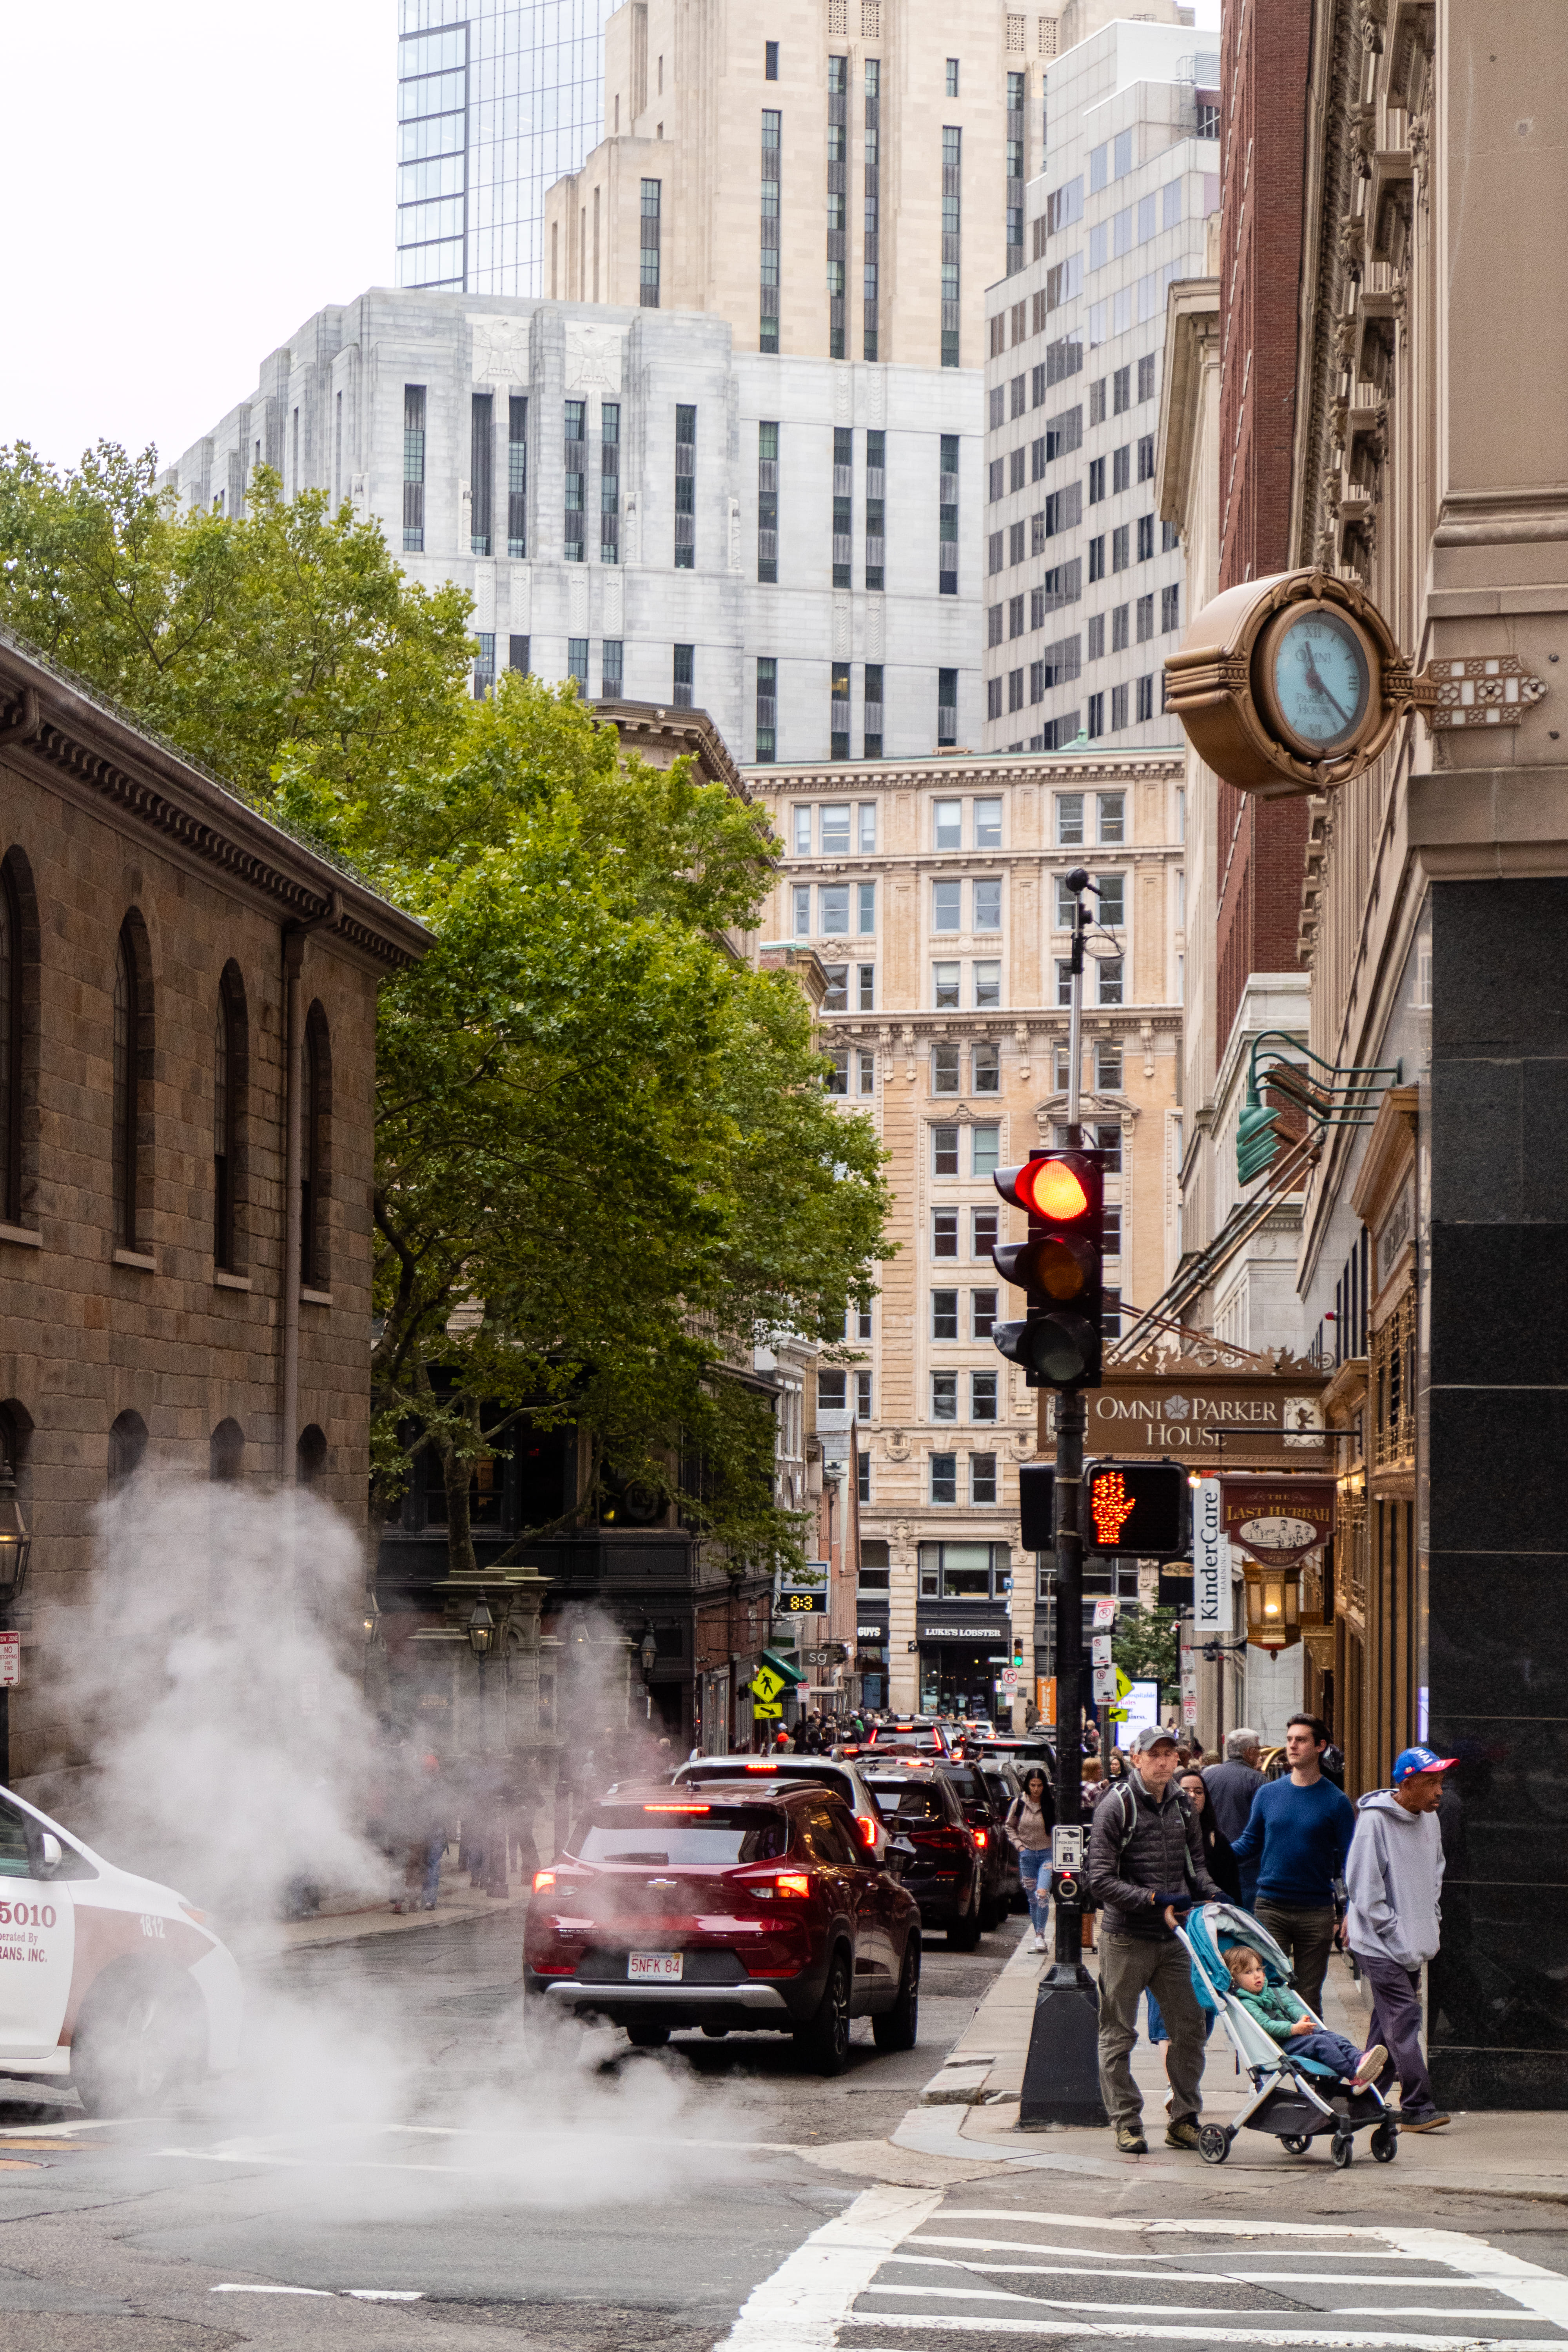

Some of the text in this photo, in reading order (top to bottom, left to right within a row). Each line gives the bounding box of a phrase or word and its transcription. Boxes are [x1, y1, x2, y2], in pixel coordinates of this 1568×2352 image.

[1304, 627, 1321, 637] XII
[1296, 692, 1332, 704] PARKE
[1096, 1396, 1278, 1421] OMNI PARKER
[1146, 1423, 1227, 1446] HOUSE
[1226, 1506, 1330, 1522] LAST HURRAH
[1201, 1492, 1218, 1621] KinderCare
[857, 1627, 881, 1637] GUYS
[809, 1653, 828, 1665] sg
[0, 1901, 56, 1928] 5010
[140, 1915, 165, 1938] 1812
[28, 1933, 38, 1945] By
[28, 1948, 47, 1963] INC.
[632, 1958, 680, 1973] 5NFK 84
